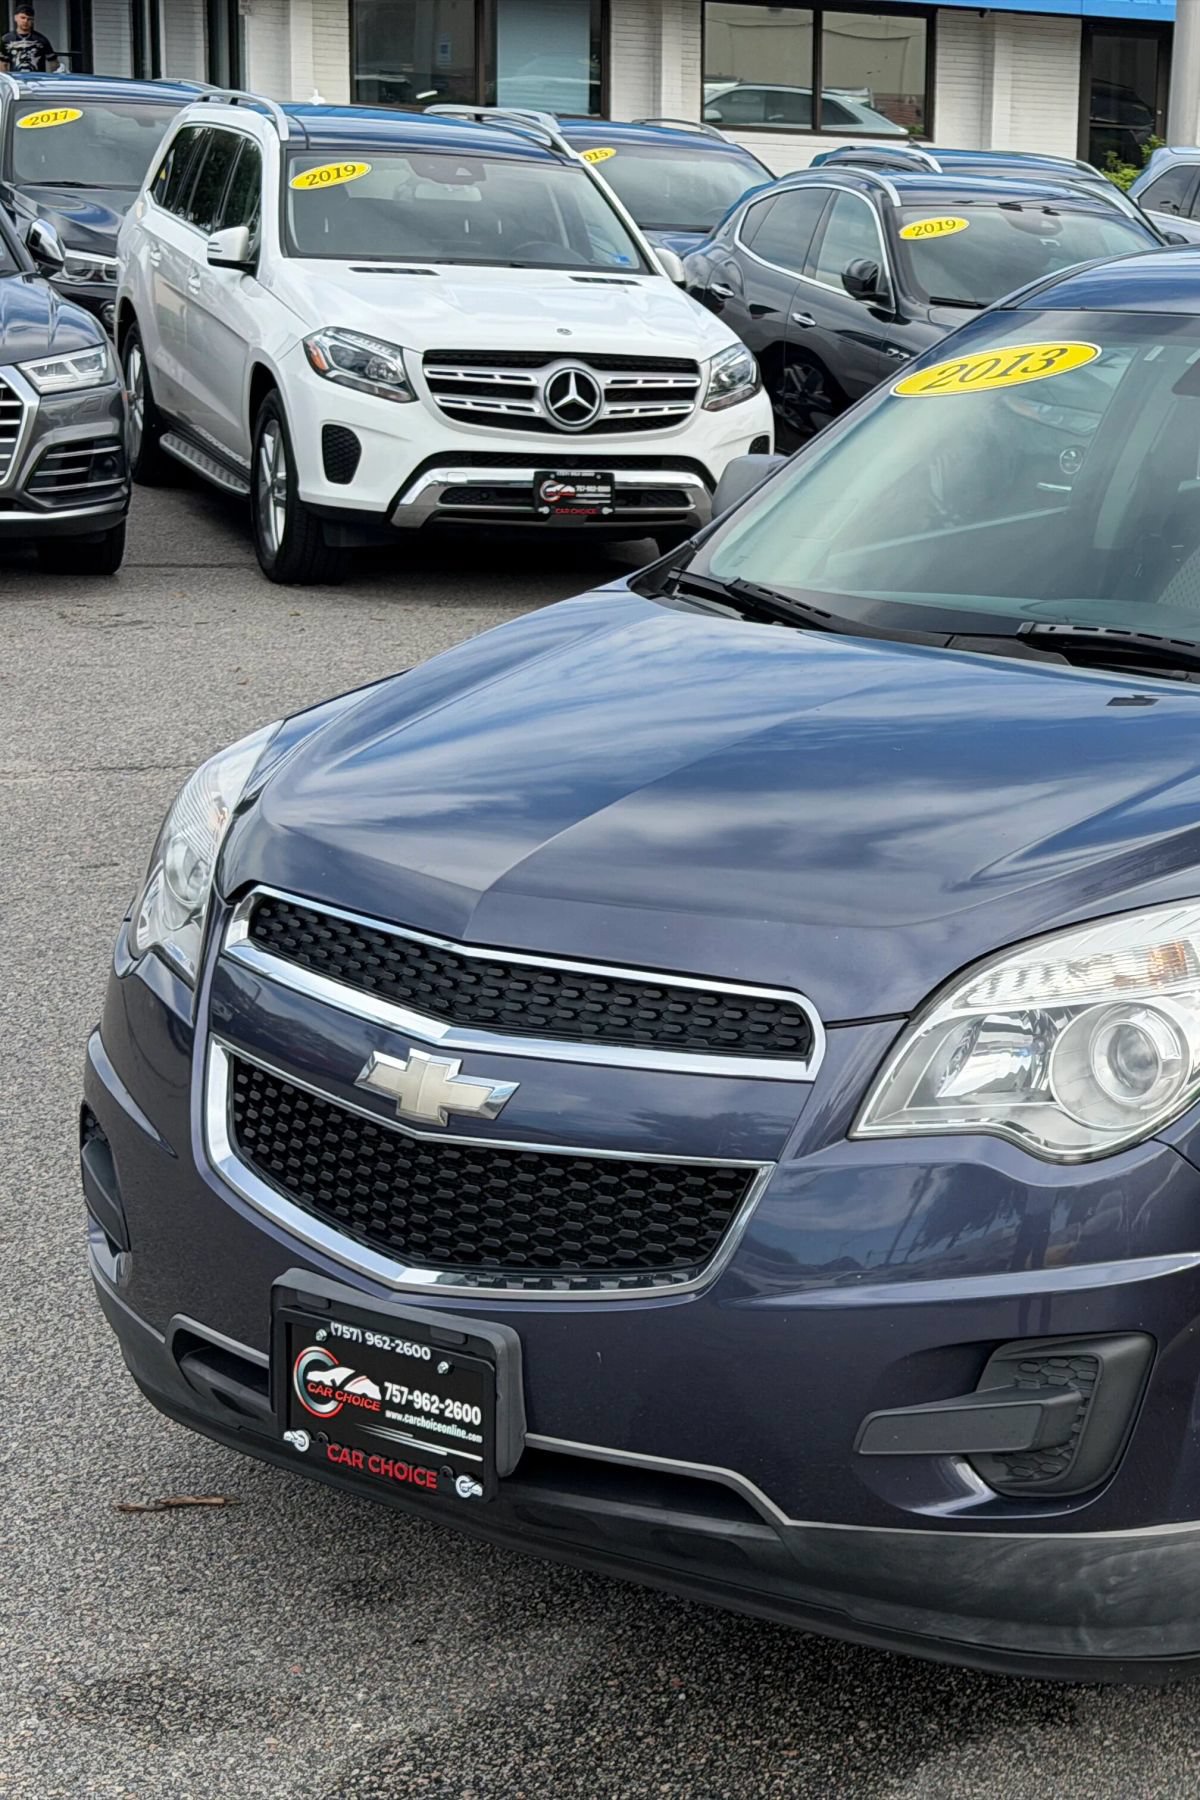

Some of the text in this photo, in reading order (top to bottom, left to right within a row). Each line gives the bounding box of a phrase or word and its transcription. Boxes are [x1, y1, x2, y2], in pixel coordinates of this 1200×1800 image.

[30, 110, 69, 126] 2017
[583, 149, 609, 161] 015
[305, 164, 357, 186] 2019
[912, 219, 957, 237] 2019
[918, 347, 1069, 392] 2013
[330, 1322, 432, 1360] (757) 962-2600
[307, 1382, 382, 1412] CAR CHOICE
[384, 1382, 482, 1426] 757-962-2600
[385, 1410, 483, 1444] www.carchoiceonline.com
[327, 1444, 438, 1489] CAR CHOICE
